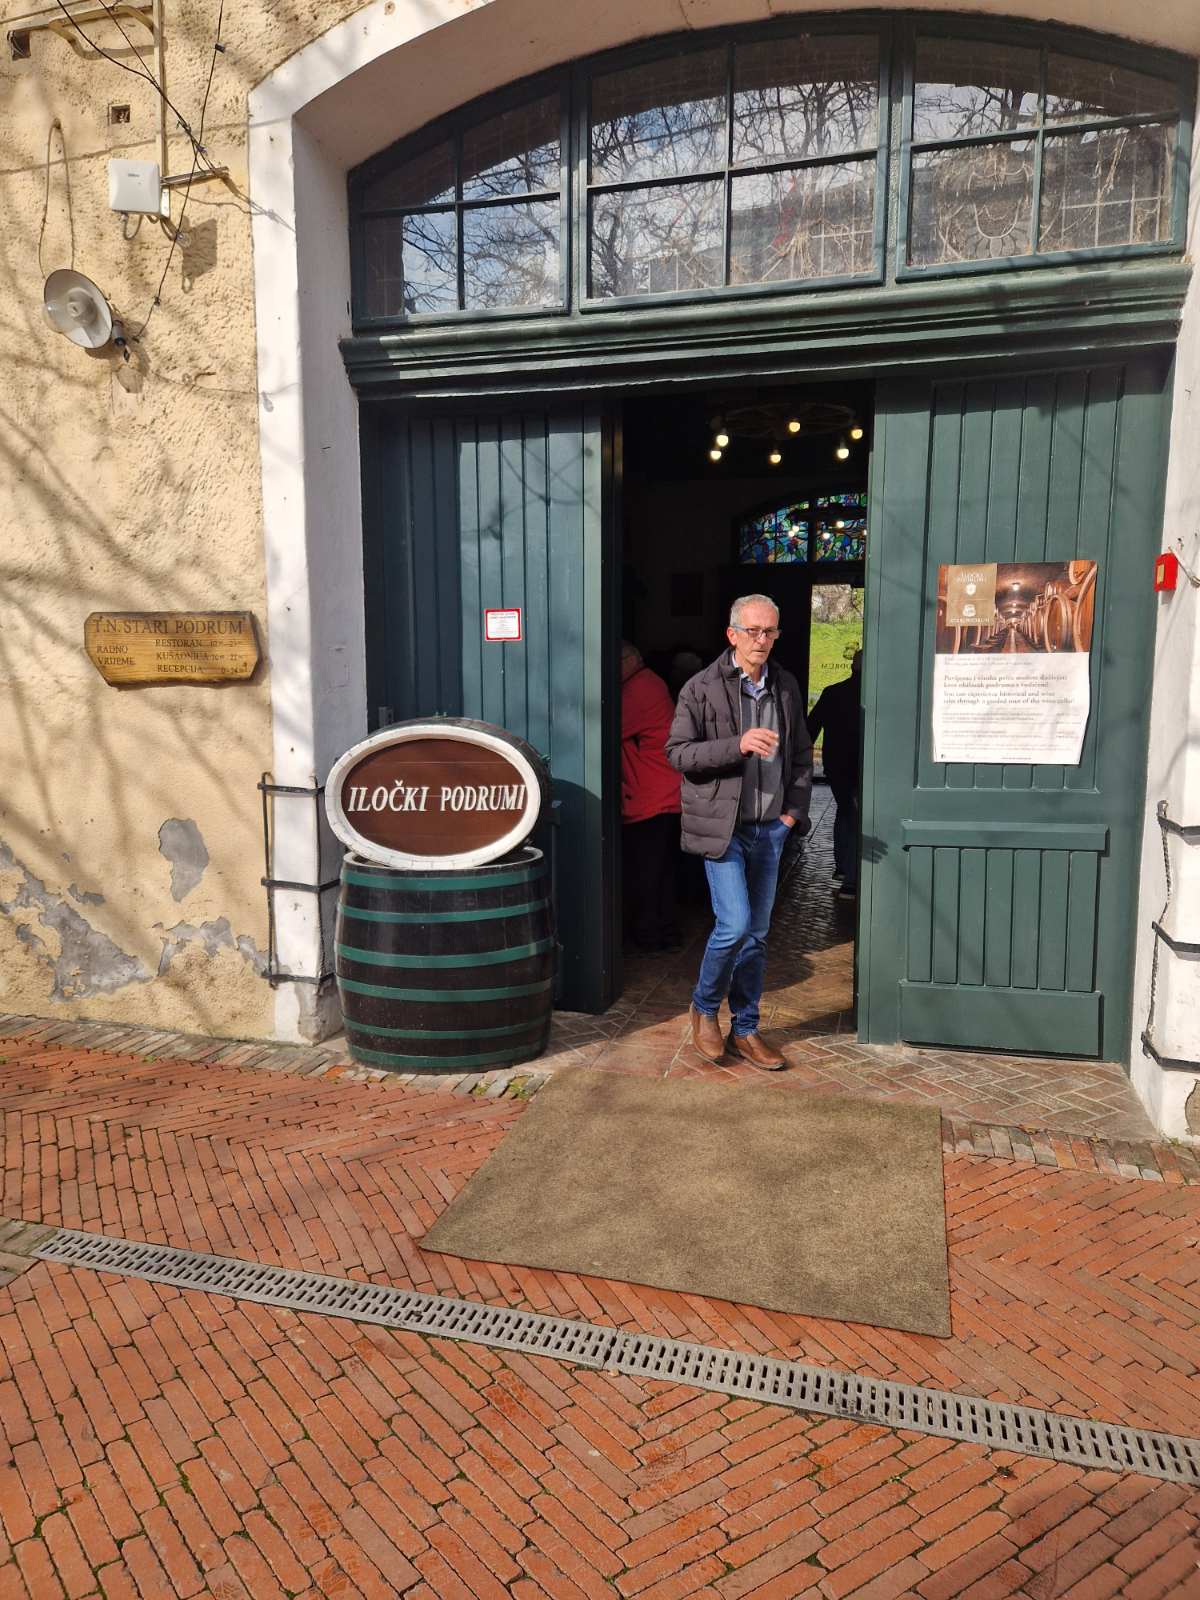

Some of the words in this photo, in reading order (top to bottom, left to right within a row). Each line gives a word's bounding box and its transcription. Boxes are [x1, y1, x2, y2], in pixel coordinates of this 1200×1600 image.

[124, 619, 169, 634] STARI
[175, 619, 243, 634] PODRUM
[96, 645, 129, 654] RADNO
[347, 779, 431, 812] ILOČKI
[440, 783, 527, 812] PODRUMI
